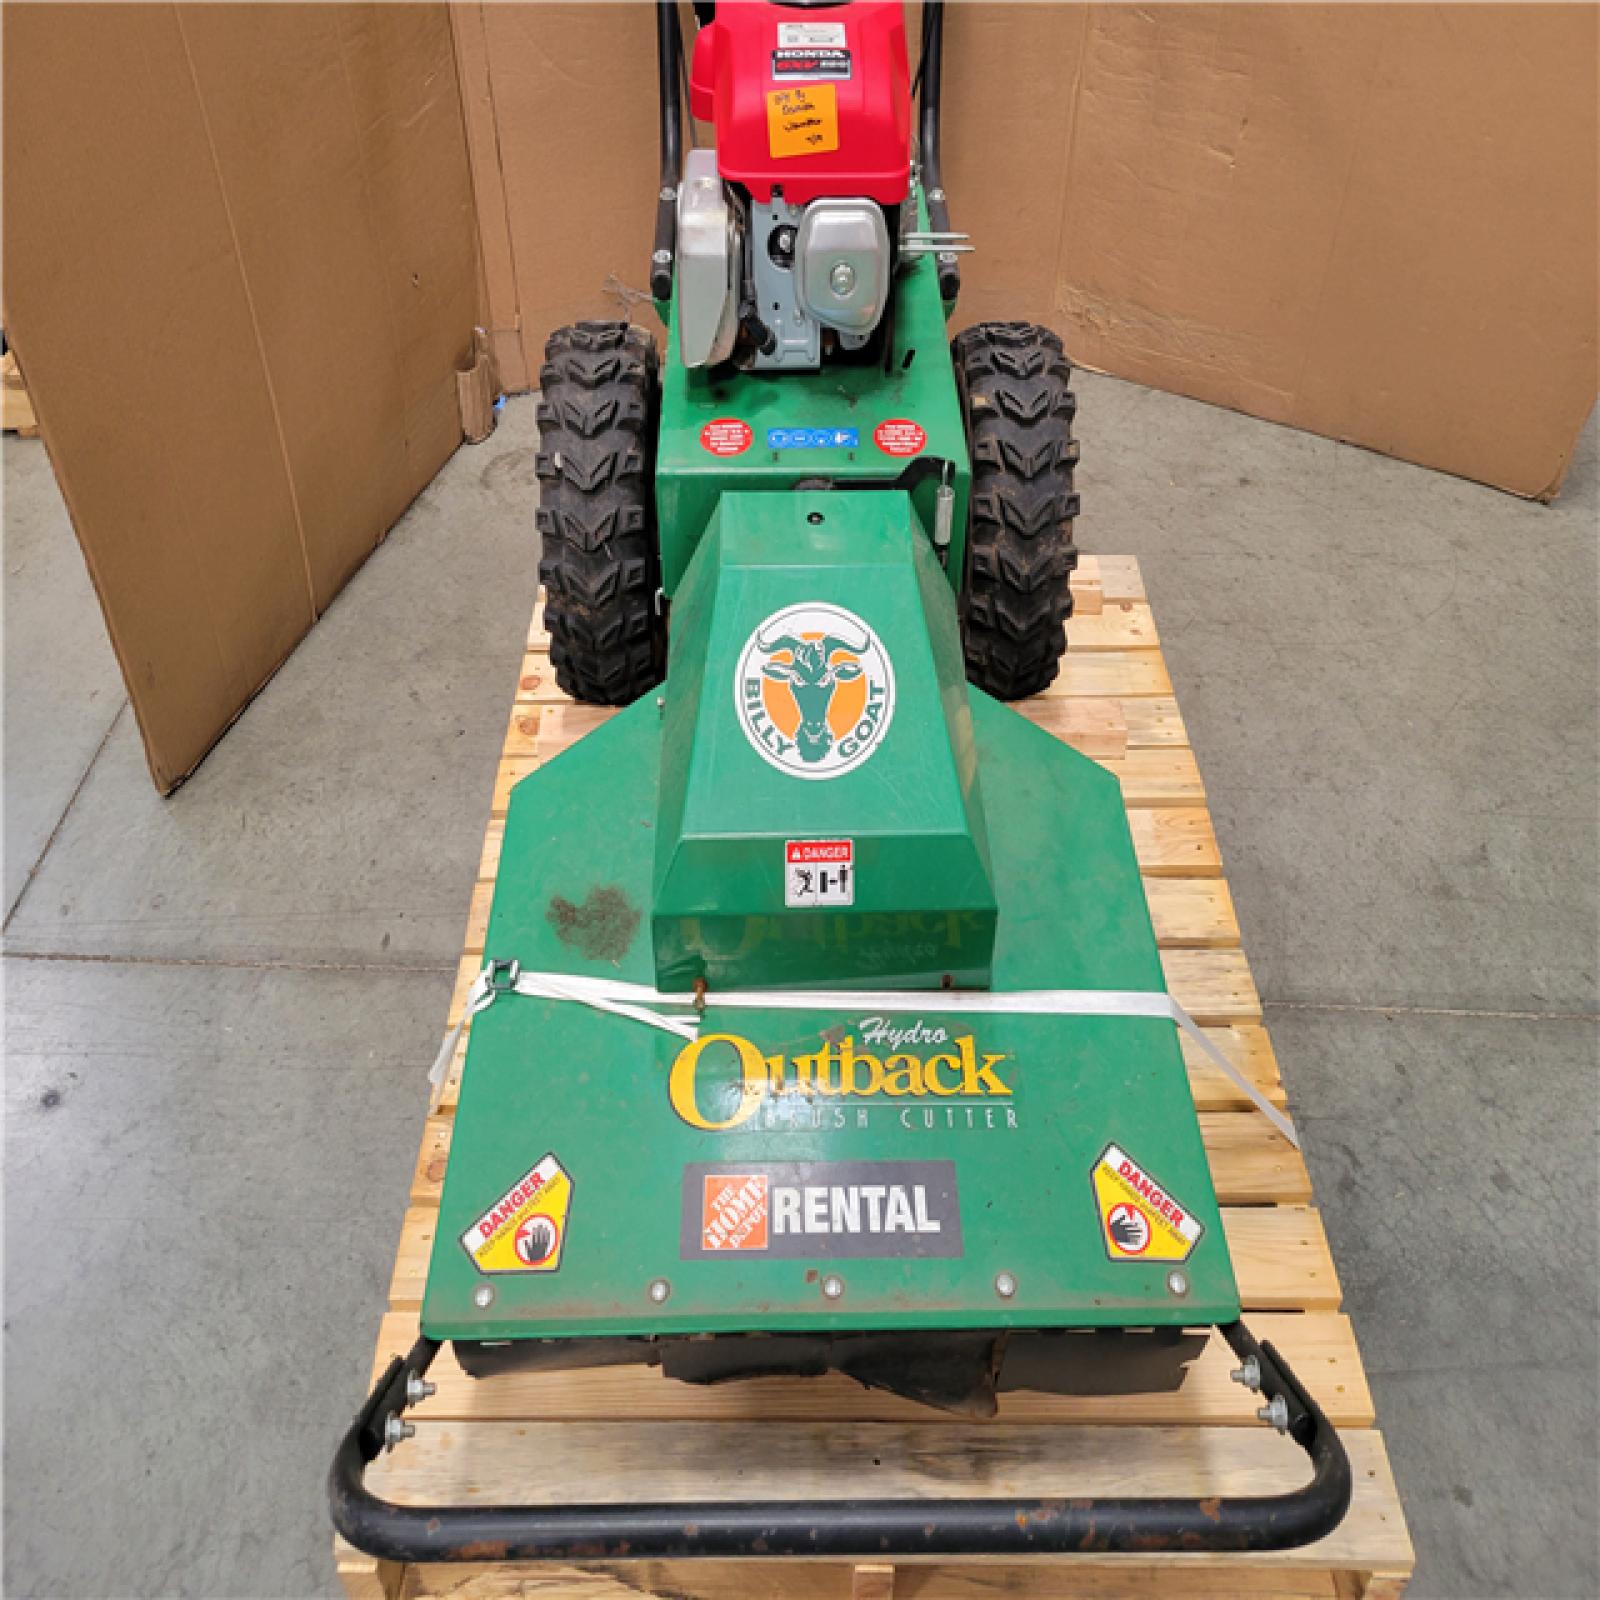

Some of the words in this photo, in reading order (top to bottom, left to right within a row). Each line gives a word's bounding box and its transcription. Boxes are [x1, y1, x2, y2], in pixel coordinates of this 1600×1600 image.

[745, 678, 795, 756] BILLY
[838, 679, 885, 758] GOAT
[804, 847, 849, 859] DANGER
[858, 1016, 948, 1051] Hydro
[668, 1033, 1014, 1131] Outback
[901, 1106, 1018, 1129] CUTTER
[479, 1171, 545, 1239] DANGER
[772, 1184, 941, 1234] RENTAL
[1119, 1161, 1185, 1228] DANGER
